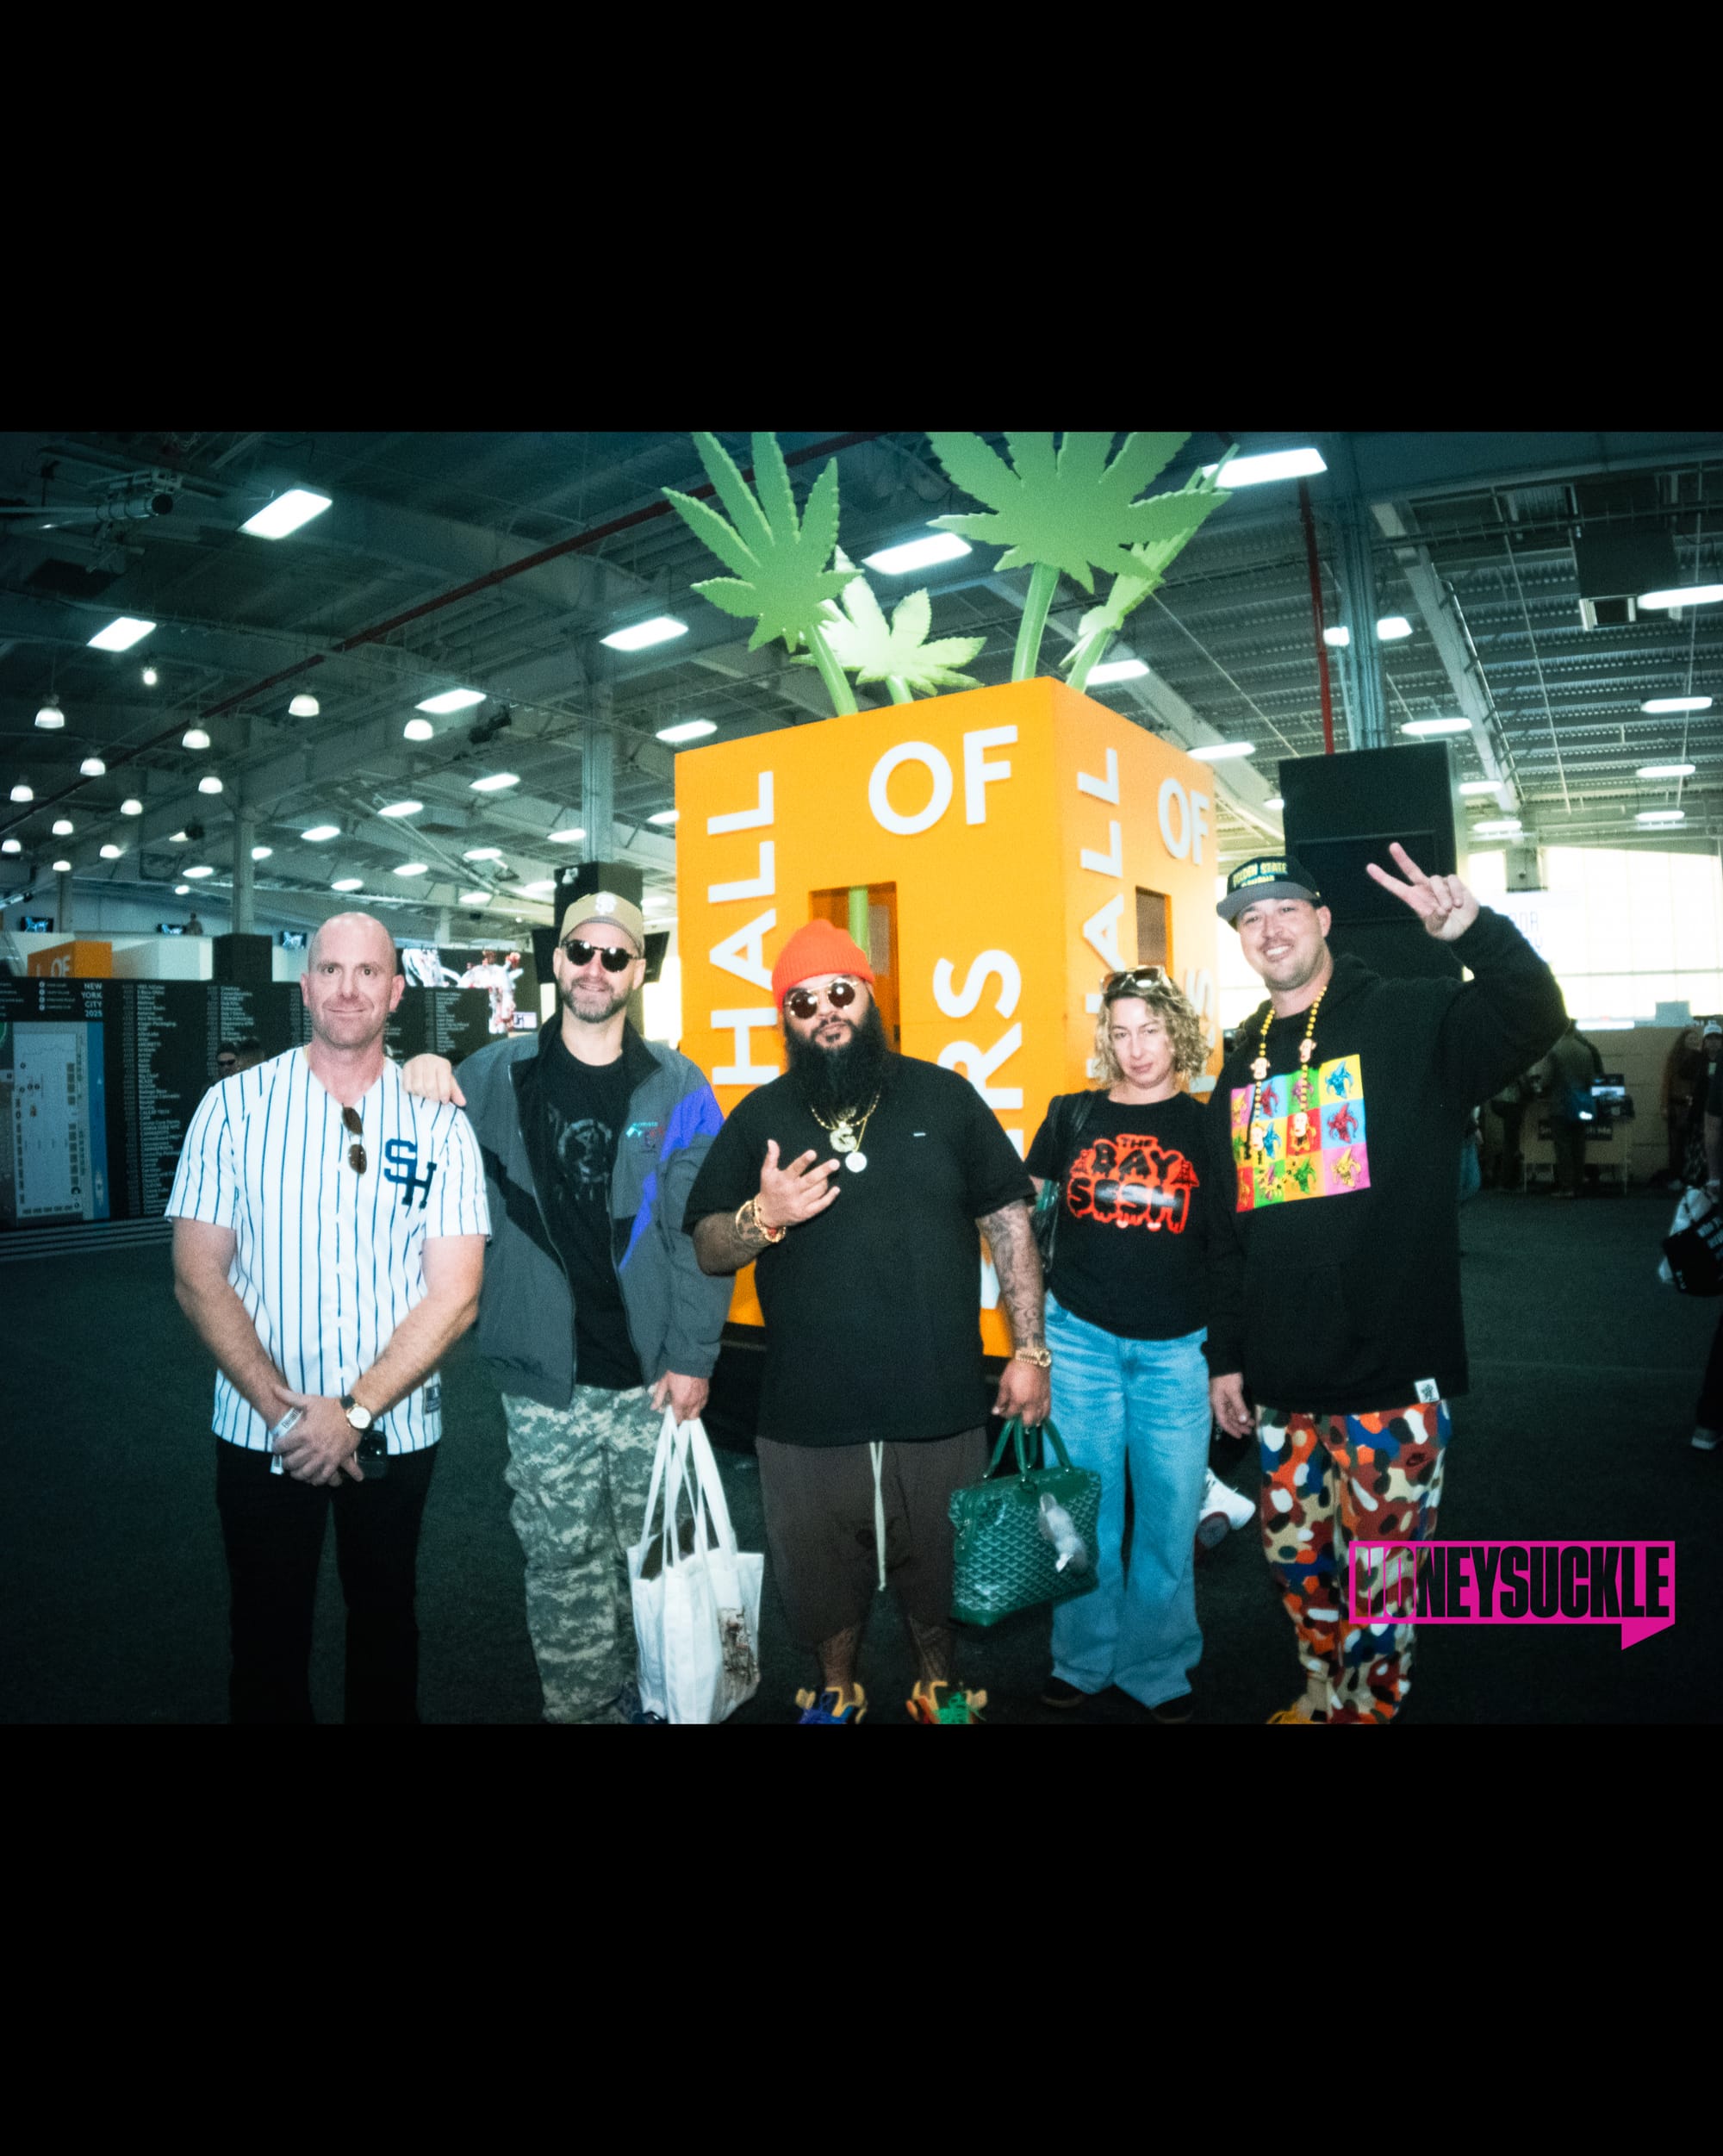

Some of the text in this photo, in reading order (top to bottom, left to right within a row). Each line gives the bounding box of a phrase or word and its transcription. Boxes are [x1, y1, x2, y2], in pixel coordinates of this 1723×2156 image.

[868, 725, 1018, 836] OF
[1157, 777, 1210, 866] OF
[706, 770, 779, 1086] HALL
[1077, 747, 1123, 1079] ALL
[81, 991, 103, 1000] YORK
[84, 1009, 103, 1018] 2025
[383, 1137, 438, 1210] SH
[1091, 1142, 1180, 1187] BAY
[1121, 1137, 1154, 1148] THE
[1069, 1177, 1187, 1228] SESH
